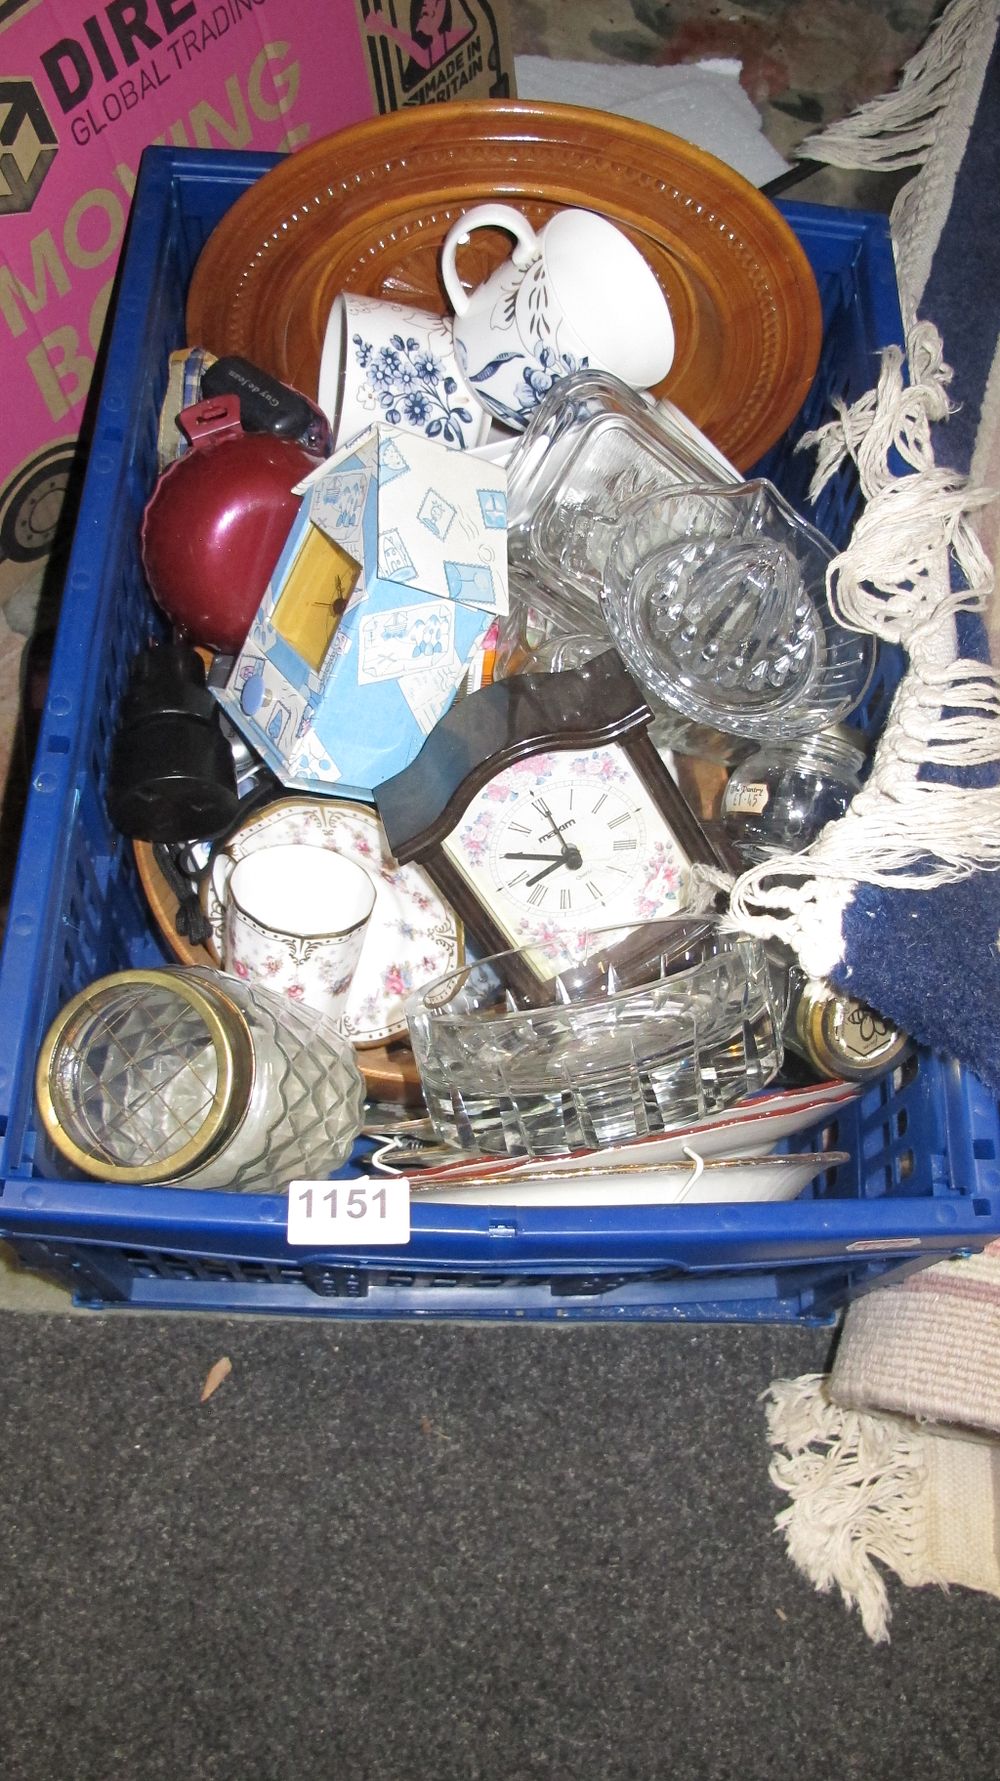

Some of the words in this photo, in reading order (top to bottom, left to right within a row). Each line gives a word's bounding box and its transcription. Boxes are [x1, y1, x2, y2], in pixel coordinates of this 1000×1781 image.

[70, 65, 171, 146] GLOBAL
[167, 0, 266, 70] TRADIN
[424, 52, 465, 99] MADE
[467, 35, 482, 58] IN
[298, 1188, 387, 1219] 1151
